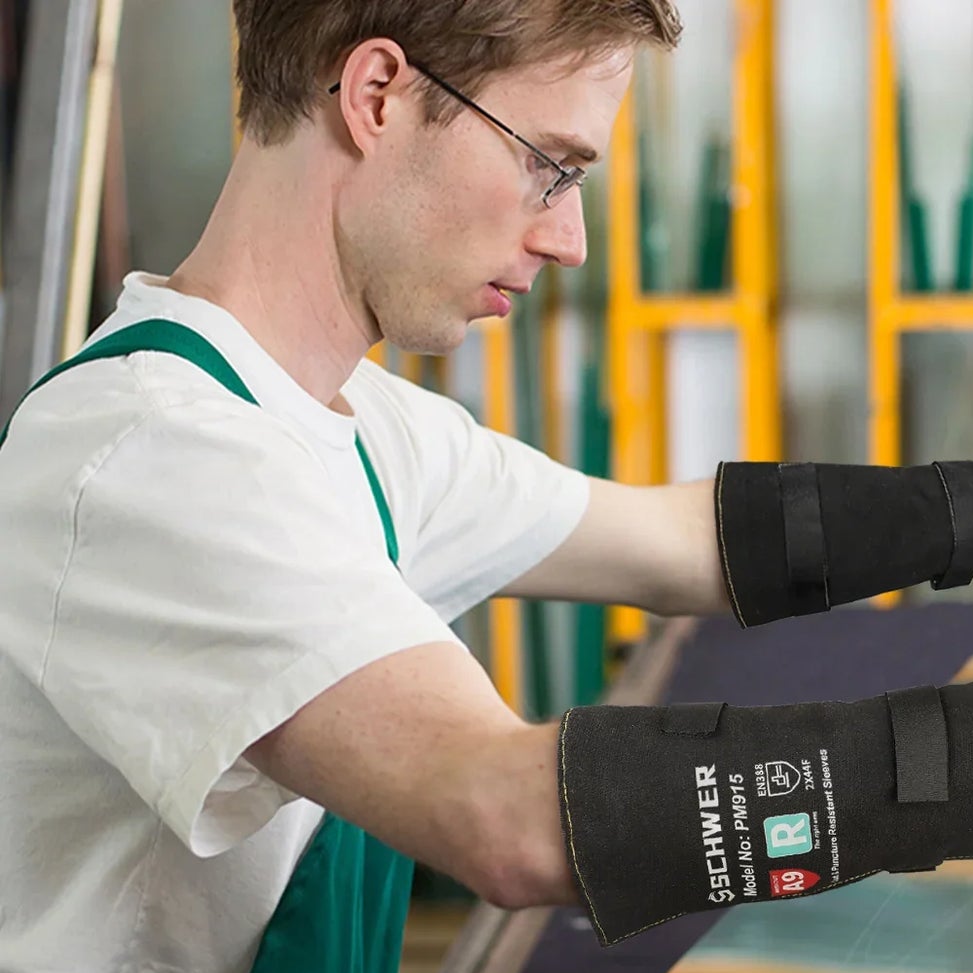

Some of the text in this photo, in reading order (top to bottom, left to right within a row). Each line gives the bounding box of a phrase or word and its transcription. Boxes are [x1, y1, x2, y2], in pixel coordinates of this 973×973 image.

[754, 763, 767, 796] EN388
[802, 759, 814, 790] 2X44F
[819, 749, 832, 788] Sleeves
[695, 763, 730, 888] SCHWER
[823, 791, 837, 835] Resistant
[729, 774, 757, 896] Model No: PM915
[770, 819, 807, 848] R
[782, 871, 804, 891] A9
